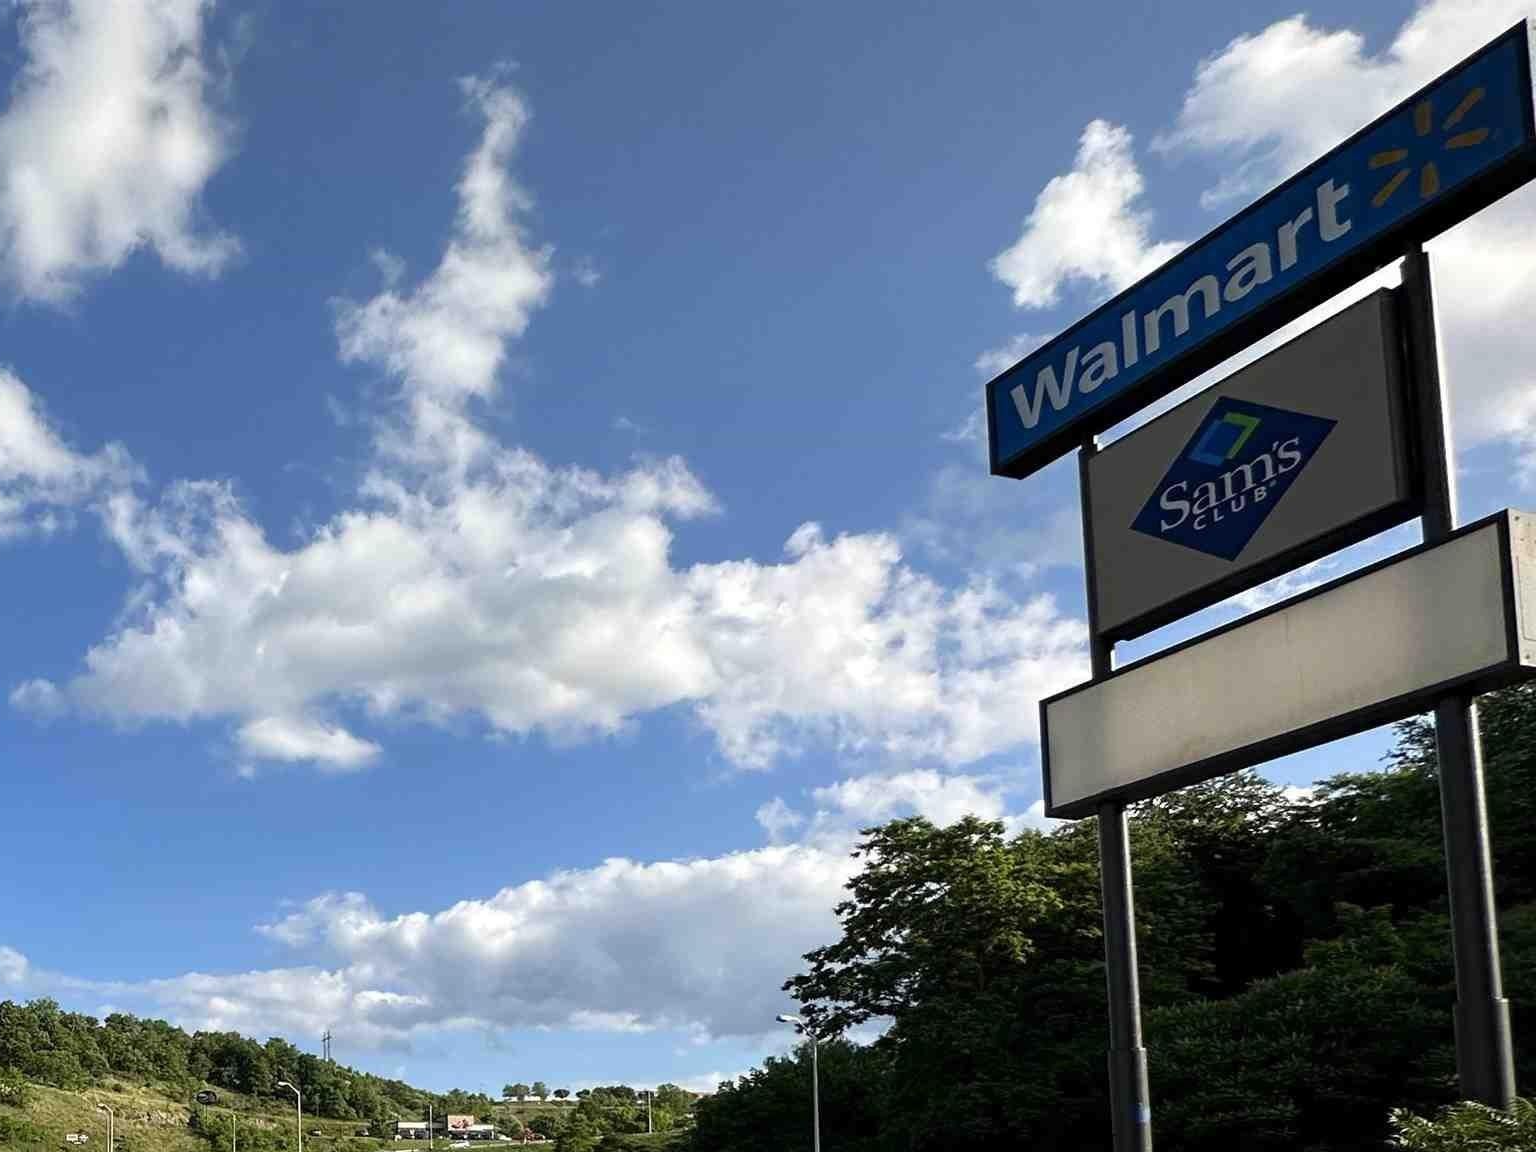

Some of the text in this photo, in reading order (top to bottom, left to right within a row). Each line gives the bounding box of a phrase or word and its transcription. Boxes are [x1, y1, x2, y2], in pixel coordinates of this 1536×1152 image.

[1011, 179, 1352, 428] Walmart
[1161, 436, 1302, 532] Sam's
[1194, 489, 1267, 530] CLUB
